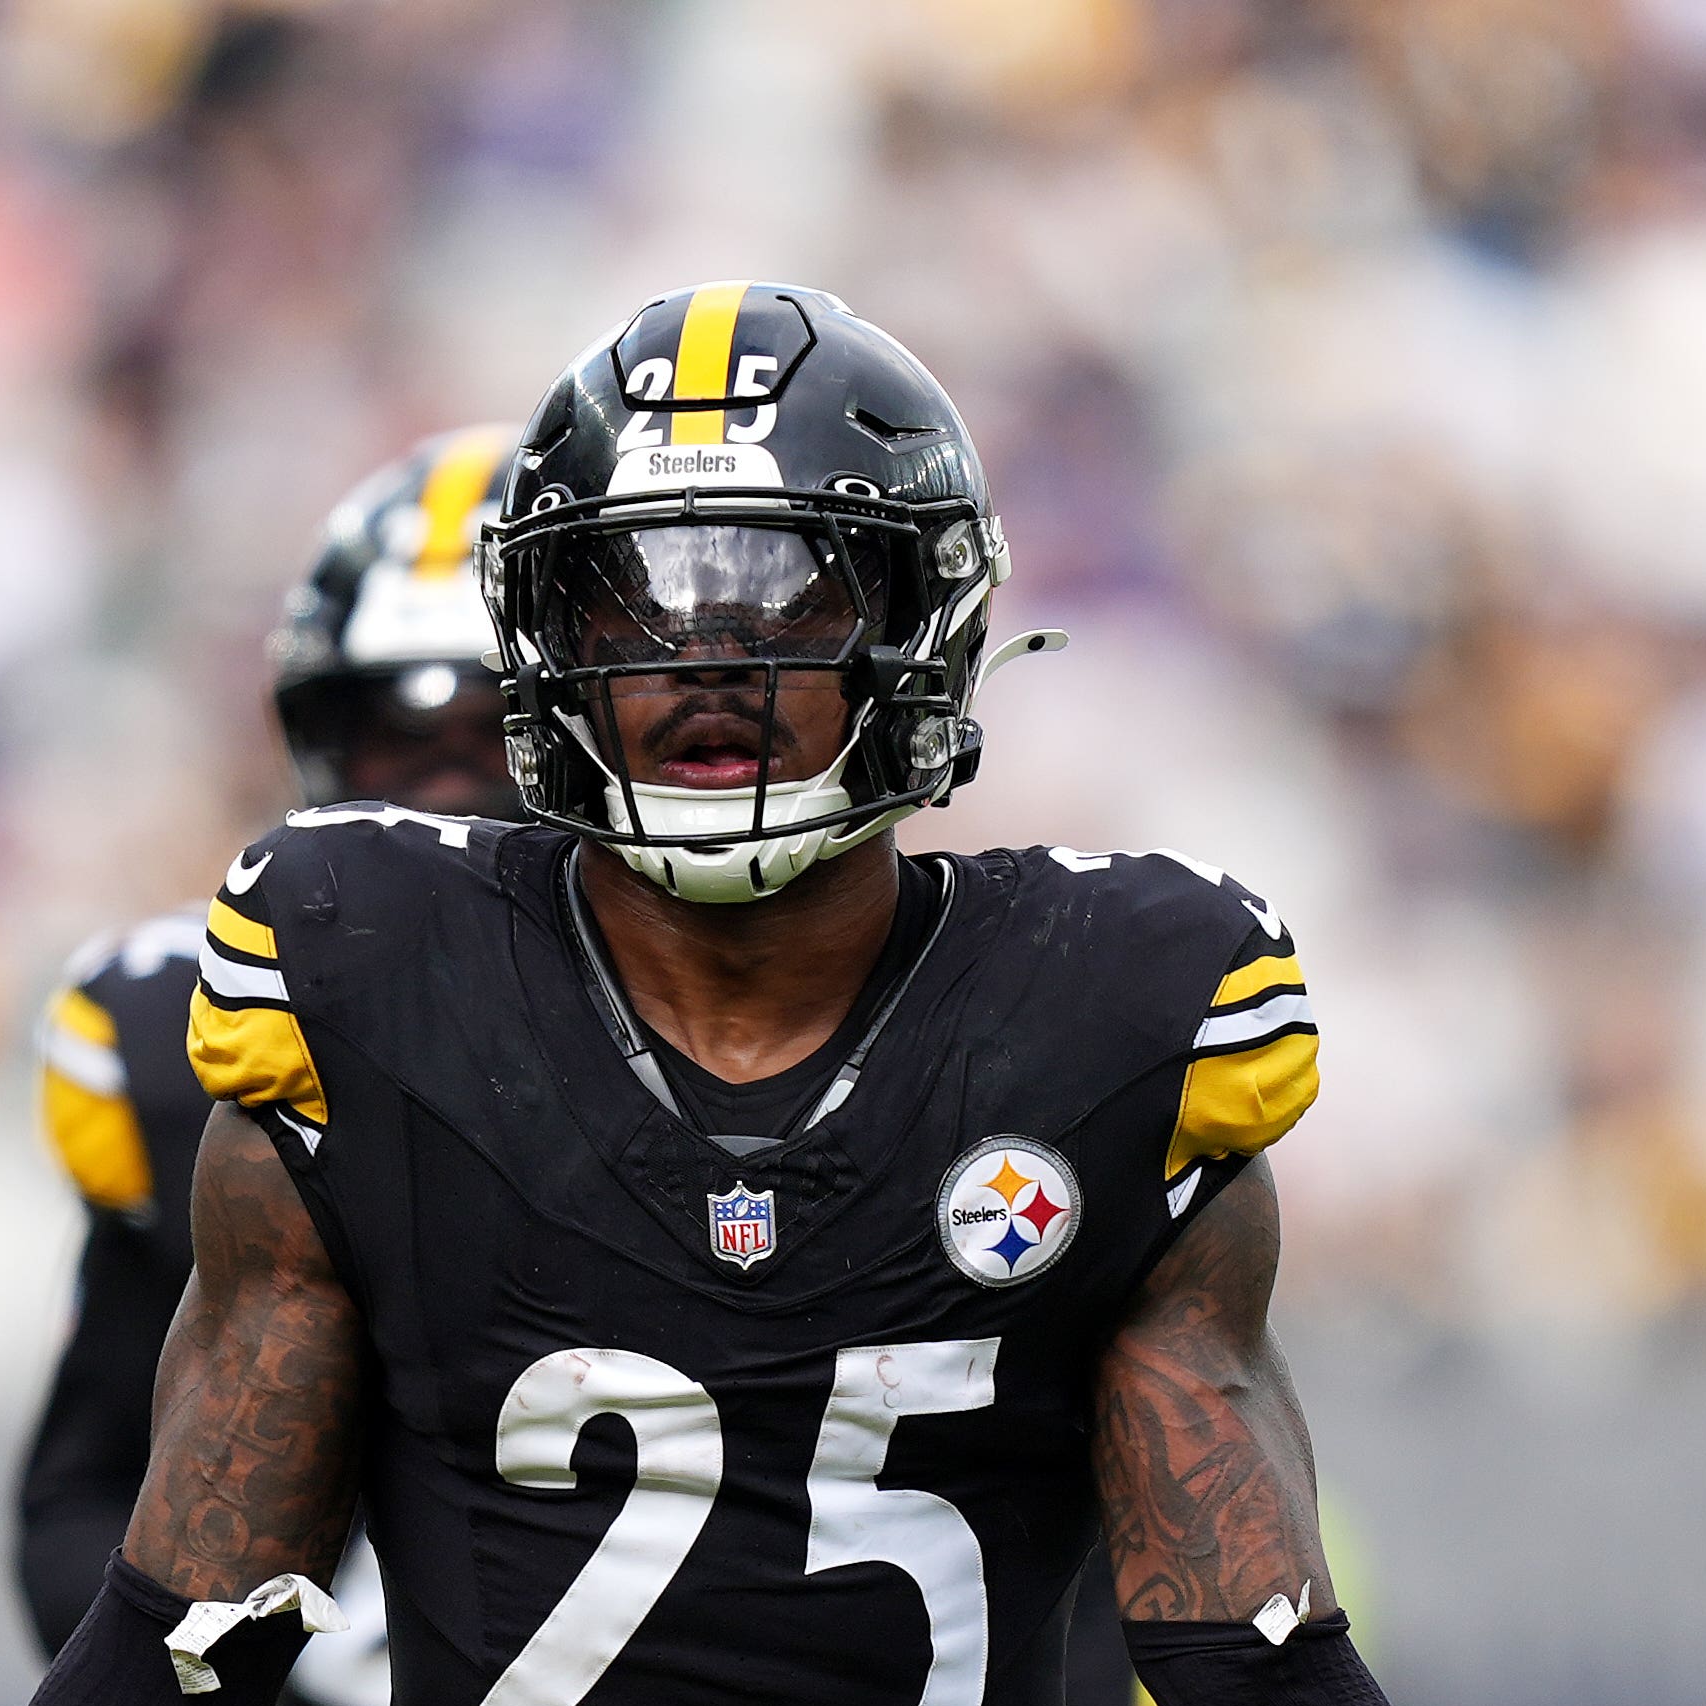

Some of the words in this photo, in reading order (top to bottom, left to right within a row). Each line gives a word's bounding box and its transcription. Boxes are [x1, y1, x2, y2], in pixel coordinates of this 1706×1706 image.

[616, 355, 778, 452] 25
[648, 449, 737, 477] Steelers
[952, 1206, 1007, 1226] Steelers
[721, 1222, 766, 1254] NFL
